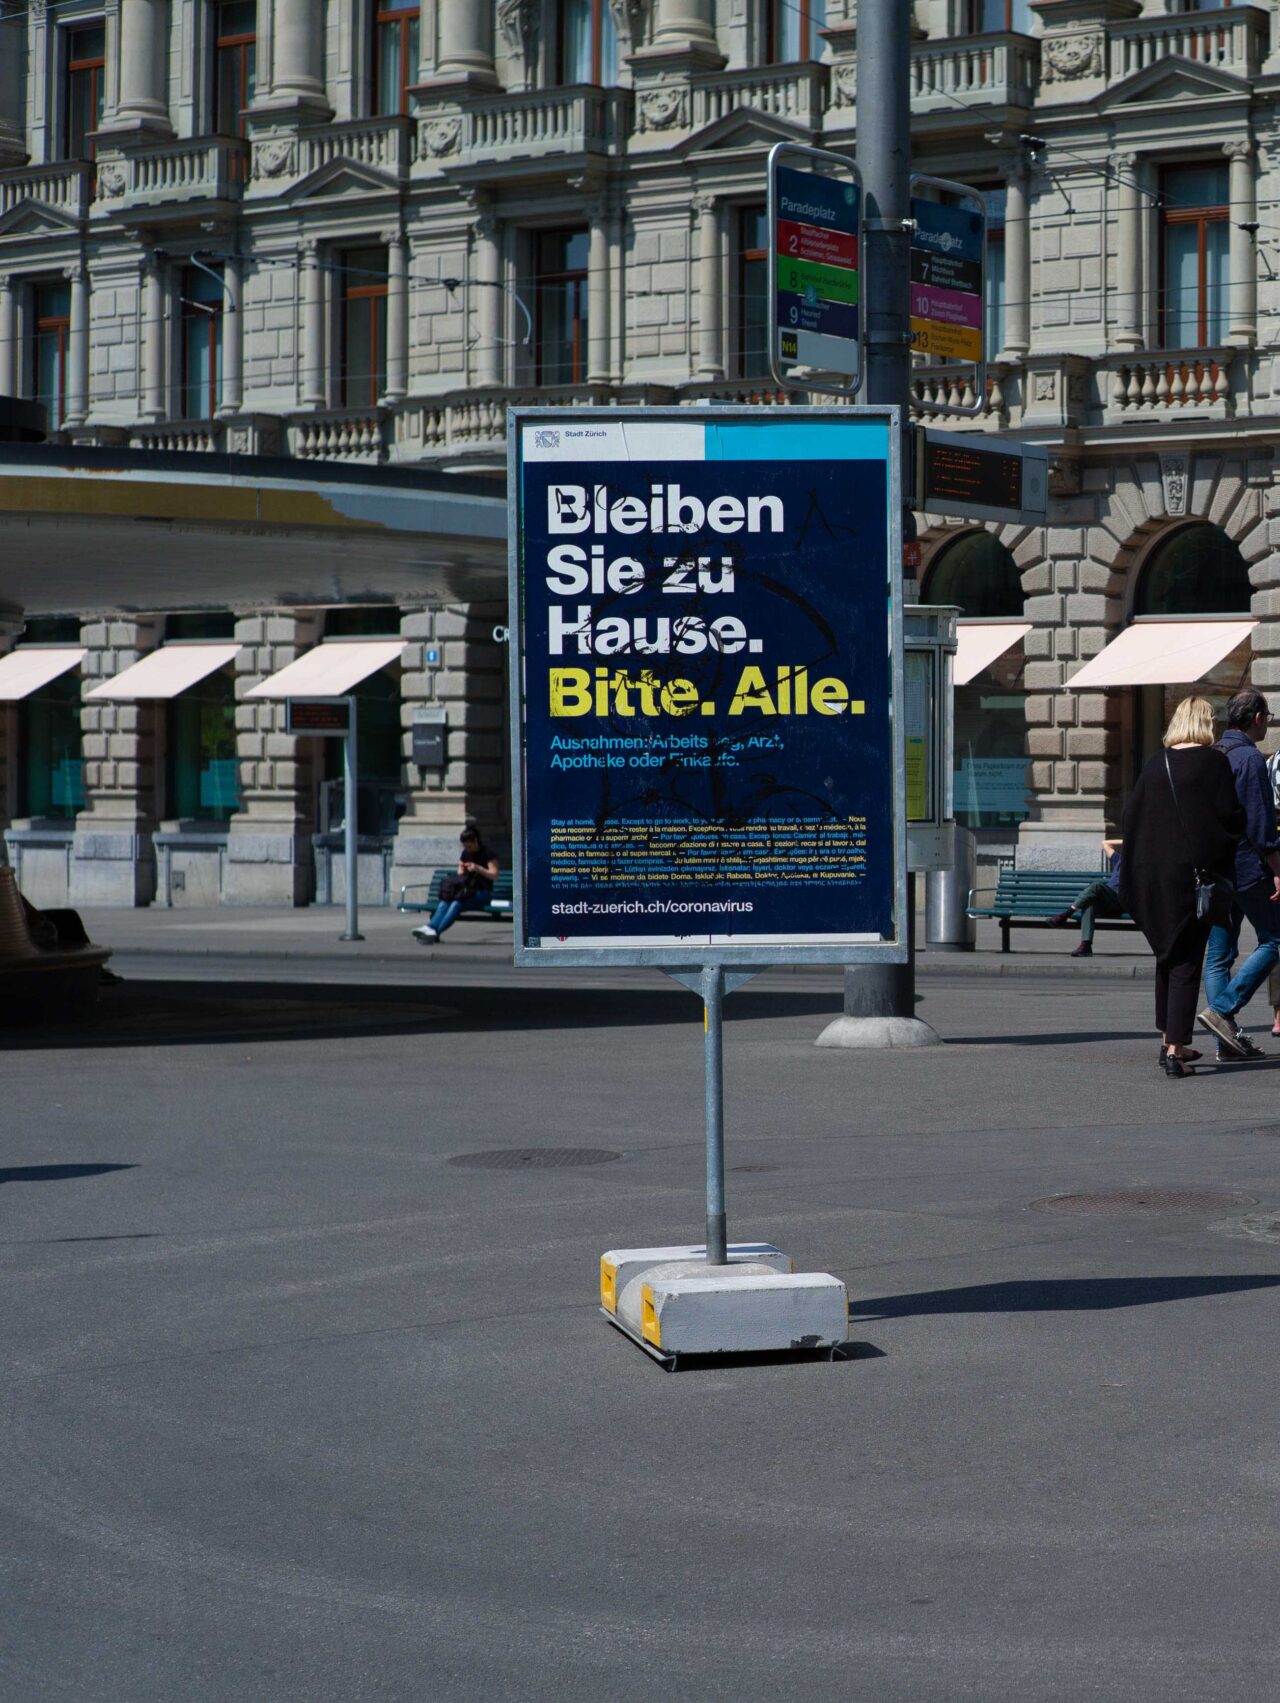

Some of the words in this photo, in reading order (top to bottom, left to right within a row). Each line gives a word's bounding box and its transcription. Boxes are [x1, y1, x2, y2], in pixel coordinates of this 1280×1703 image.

[781, 196, 836, 221] Paradeplatz
[789, 234, 798, 253] 2
[790, 271, 798, 288] 8
[921, 262, 929, 280] 7
[916, 296, 929, 314] 10
[790, 305, 798, 324] 9
[782, 340, 797, 353] N14
[916, 330, 929, 348] 13
[547, 484, 784, 535] Bleiben
[546, 544, 644, 596] Sie
[662, 557, 735, 594] zu
[549, 604, 764, 656] Hause.
[549, 666, 717, 718] Bitte.
[728, 664, 865, 716] Alle.
[551, 736, 648, 750] Ausnahmen:
[655, 735, 745, 751] Arbeitseg,
[748, 735, 784, 750] Arzt,
[551, 754, 625, 771] Apotheke
[629, 753, 665, 768] oder
[551, 818, 566, 826] Stay
[622, 818, 645, 826] Except
[673, 817, 691, 825] work,
[551, 834, 585, 842] pharmacie
[749, 833, 792, 841] Excepiones:
[552, 900, 754, 915] stadt-zuerich.ch/coronavirus
